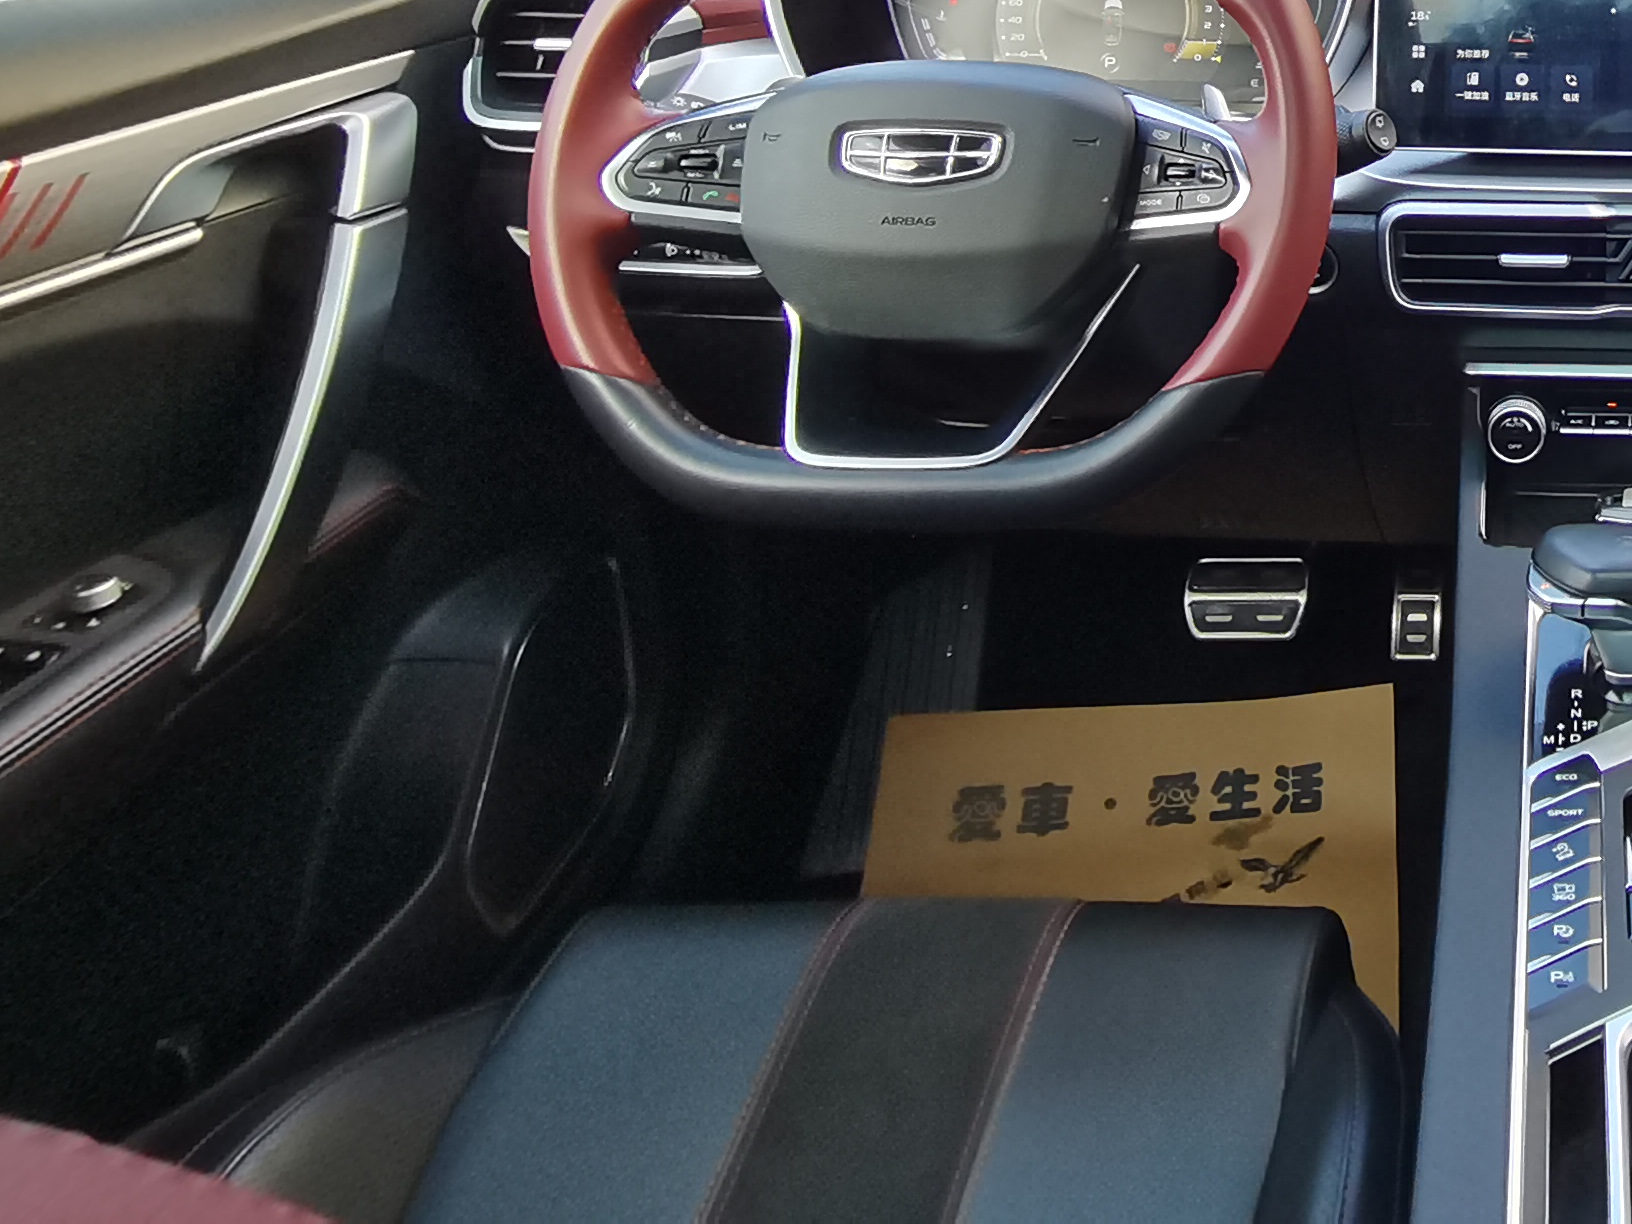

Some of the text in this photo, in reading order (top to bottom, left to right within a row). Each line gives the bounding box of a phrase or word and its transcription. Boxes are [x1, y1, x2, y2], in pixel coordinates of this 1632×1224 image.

[1007, 16, 1023, 24] 40
[1010, 33, 1025, 41] 20
[880, 216, 937, 227] AIRBAG
[1570, 688, 1583, 699] R
[1570, 708, 1582, 719] N
[1587, 720, 1599, 731] P
[1543, 735, 1555, 745] M
[1569, 733, 1582, 744] D
[1554, 773, 1578, 781] ECO
[1547, 808, 1585, 817] SPORT
